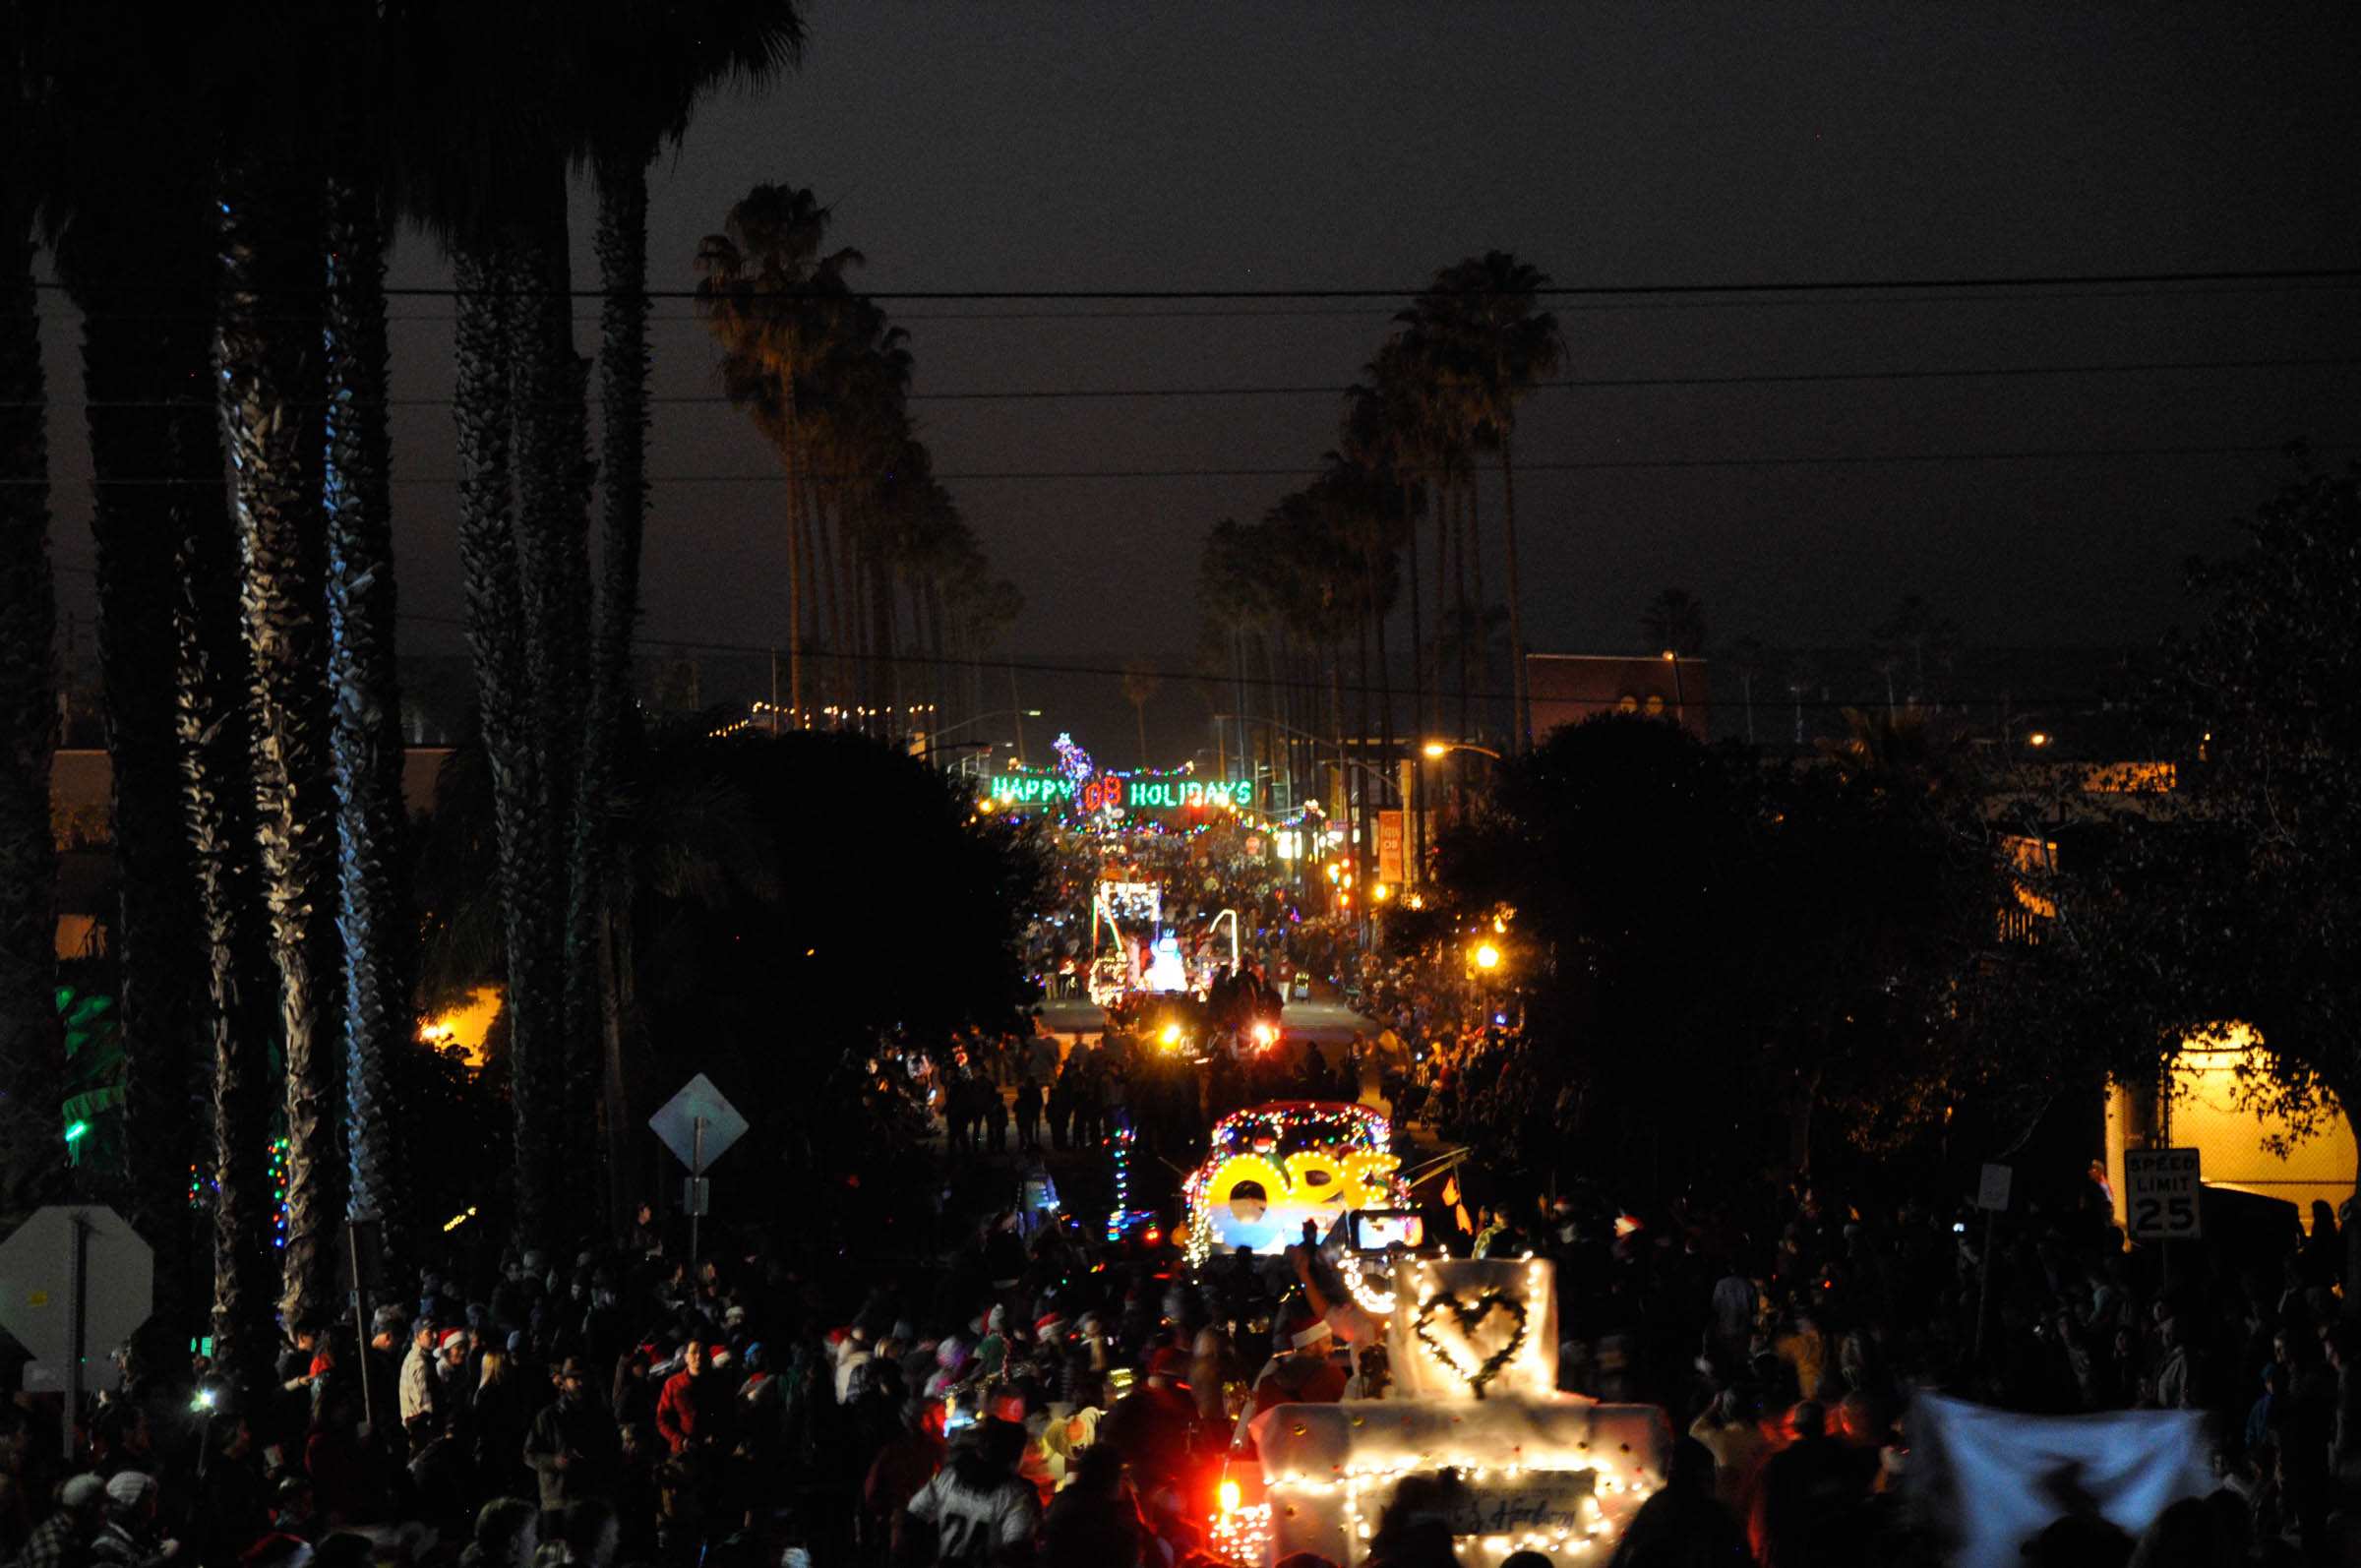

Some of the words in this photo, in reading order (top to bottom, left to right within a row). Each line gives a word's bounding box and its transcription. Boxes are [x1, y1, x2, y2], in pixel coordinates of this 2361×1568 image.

[992, 777, 1076, 802] HAPPY
[1085, 776, 1121, 811] OB
[1130, 780, 1251, 807] HOLIDAYS
[2130, 1156, 2195, 1172] SPEED
[2137, 1177, 2190, 1192] LIMIT
[2136, 1198, 2195, 1230] 25
